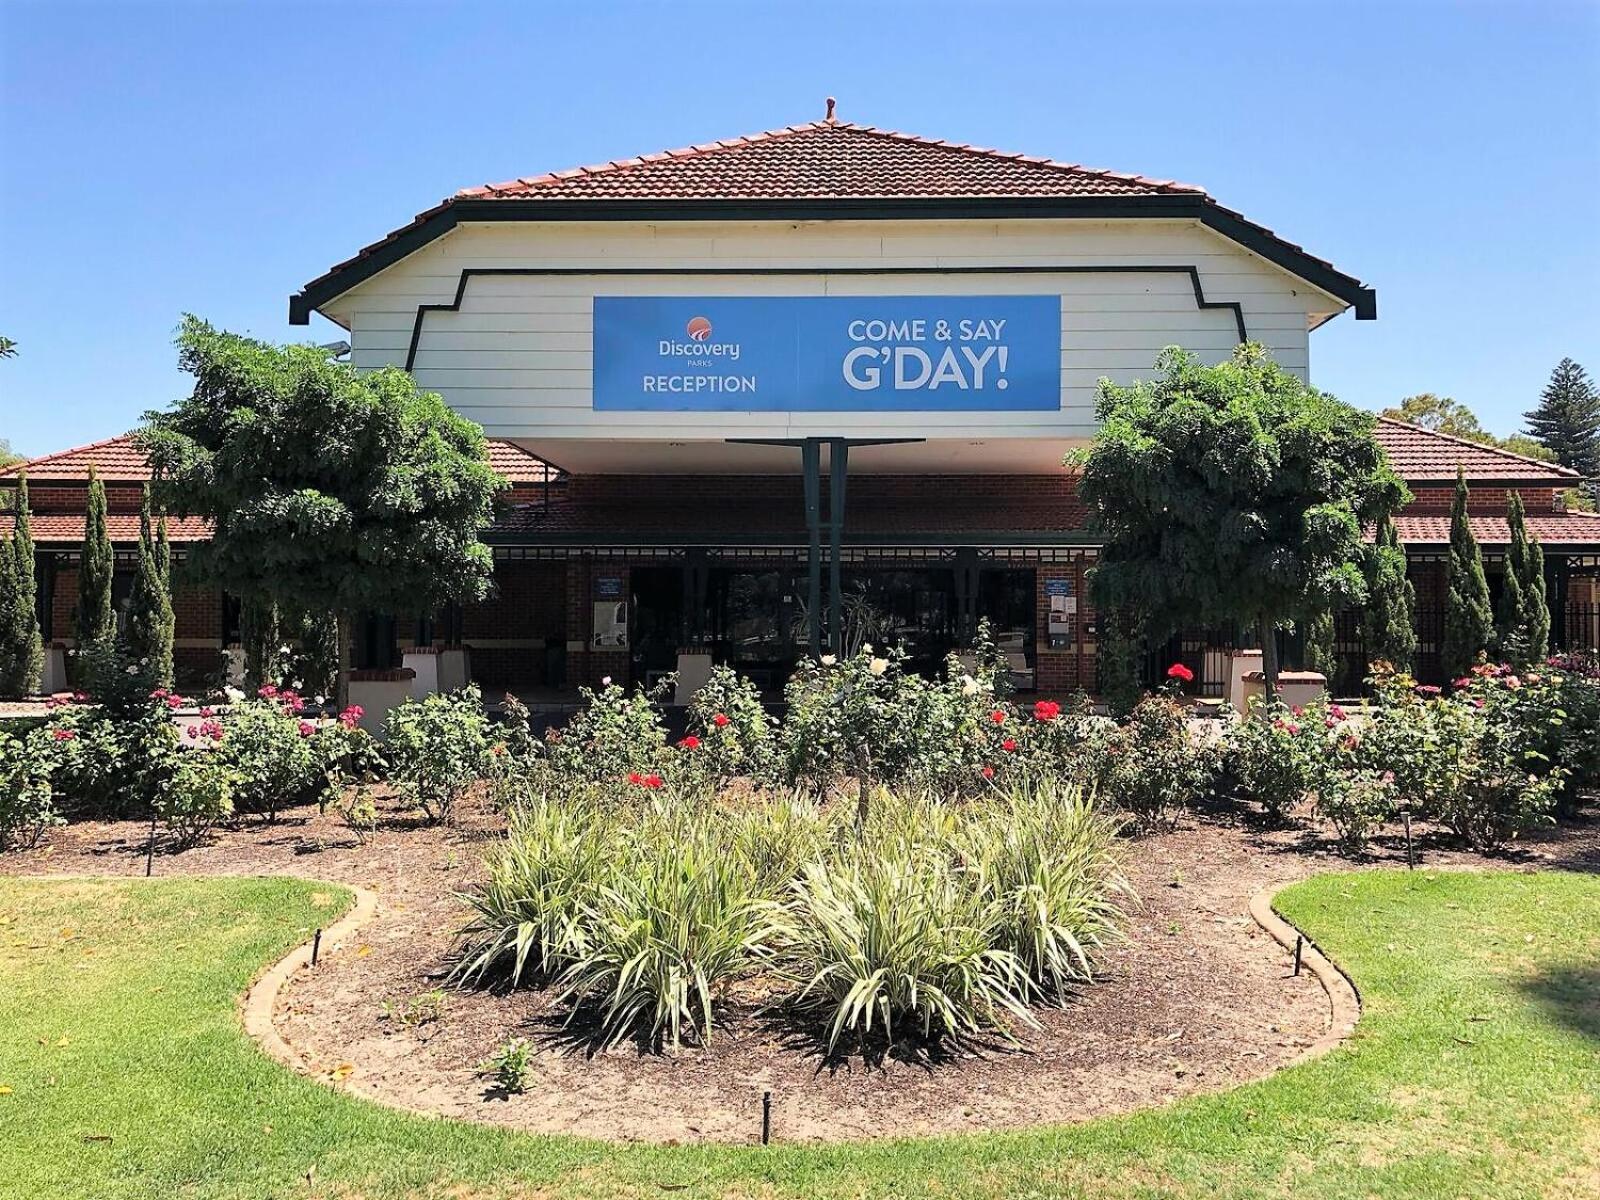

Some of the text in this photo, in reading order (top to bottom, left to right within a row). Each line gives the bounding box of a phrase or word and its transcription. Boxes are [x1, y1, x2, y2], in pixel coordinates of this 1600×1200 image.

[848, 319, 1006, 341] COME & SAY
[658, 341, 740, 360] Discovery
[687, 359, 713, 368] PARKS
[843, 346, 1008, 390] G'DAY!
[643, 376, 756, 392] RECEPTION
